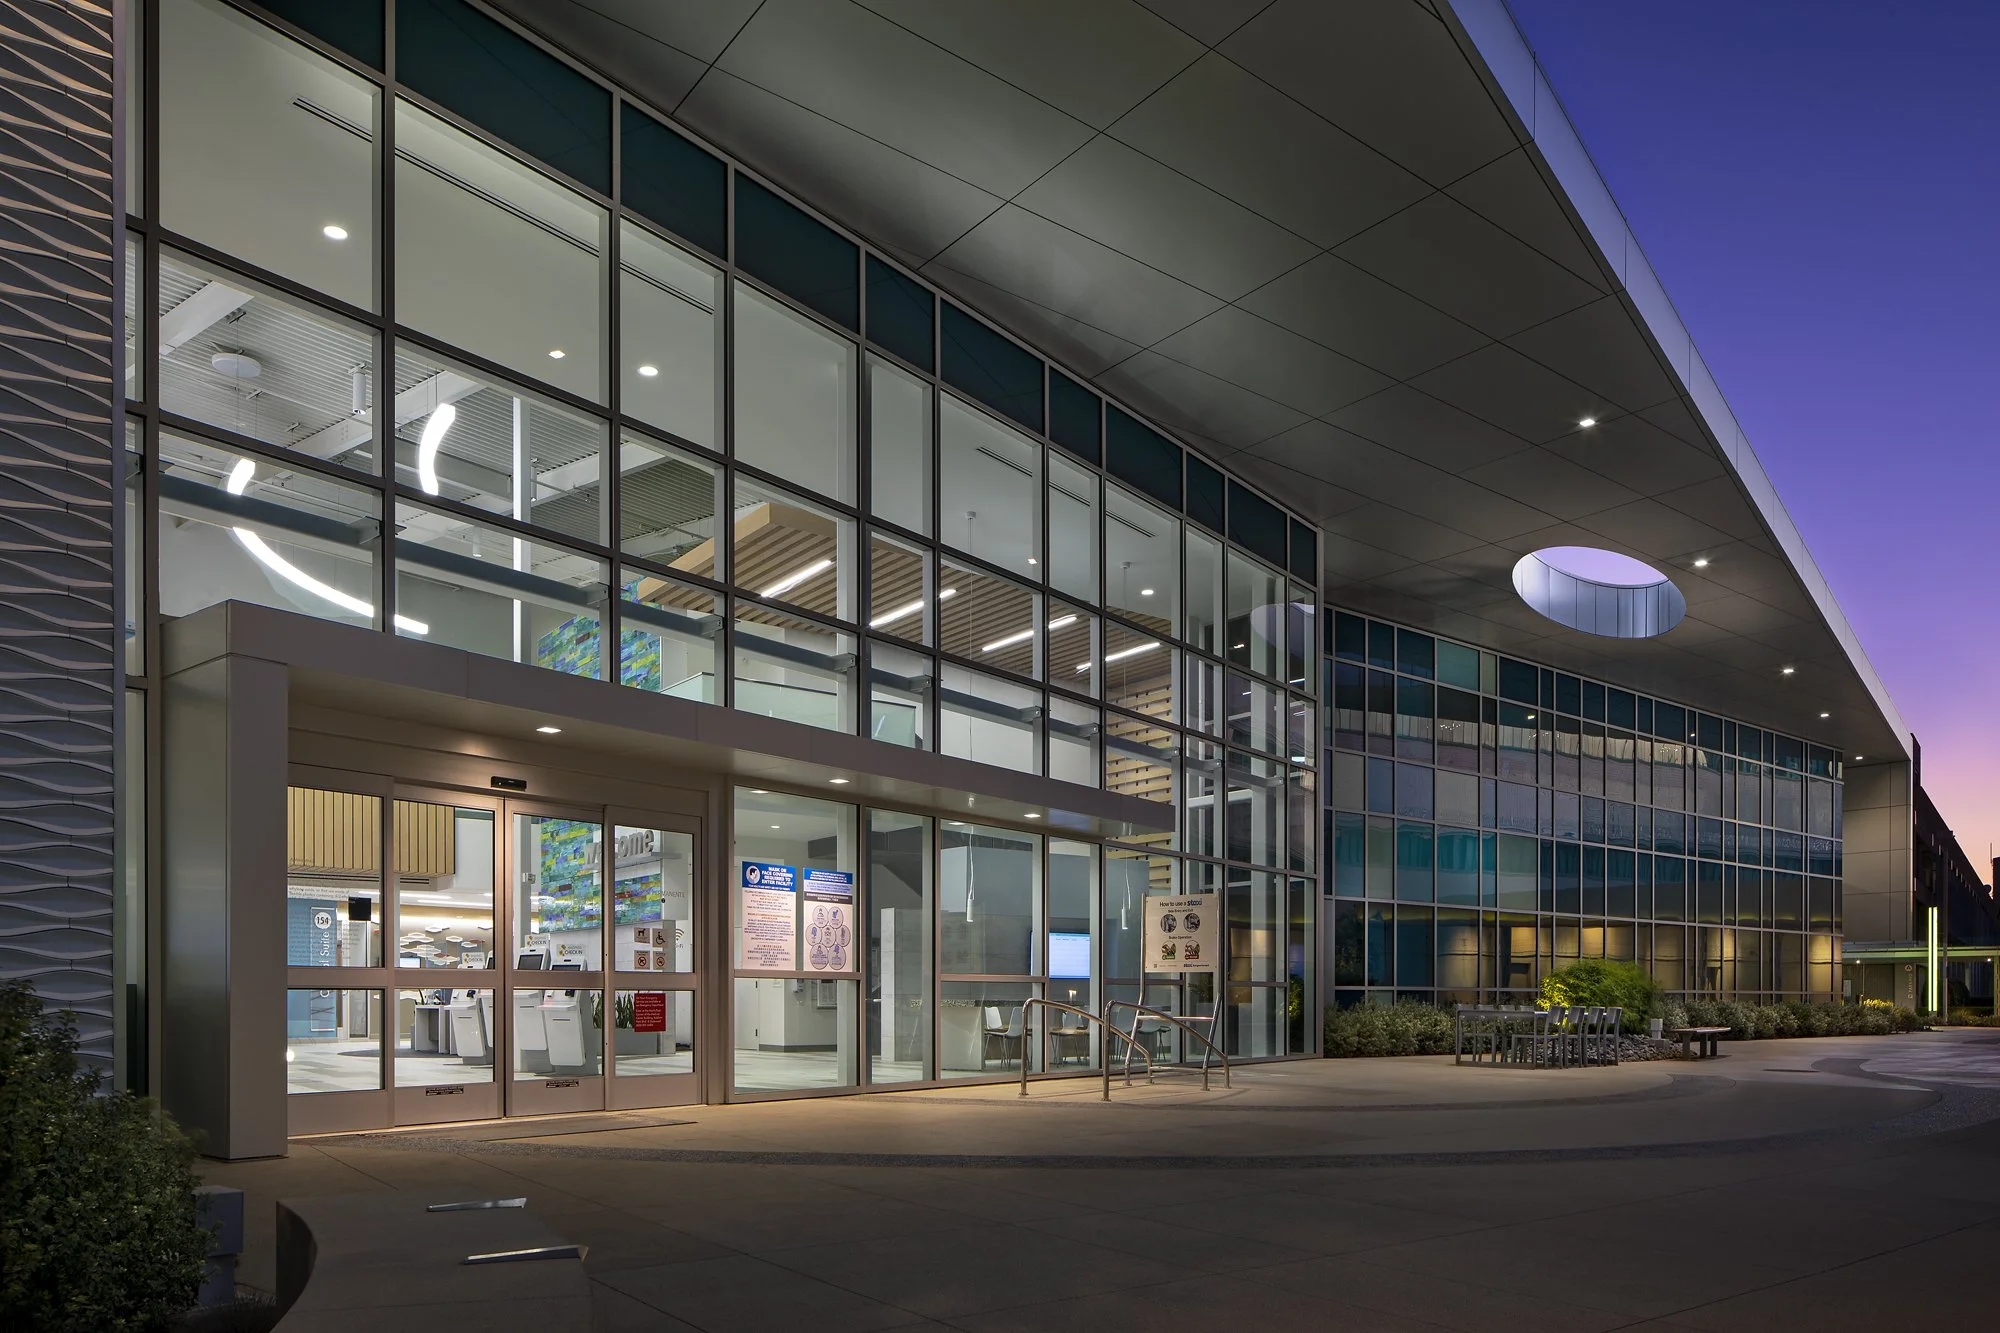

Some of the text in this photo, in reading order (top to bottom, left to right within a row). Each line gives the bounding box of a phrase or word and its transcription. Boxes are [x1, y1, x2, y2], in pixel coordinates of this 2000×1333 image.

[584, 830, 654, 863] wome
[316, 916, 330, 925] 154
[319, 931, 330, 957] Suite
